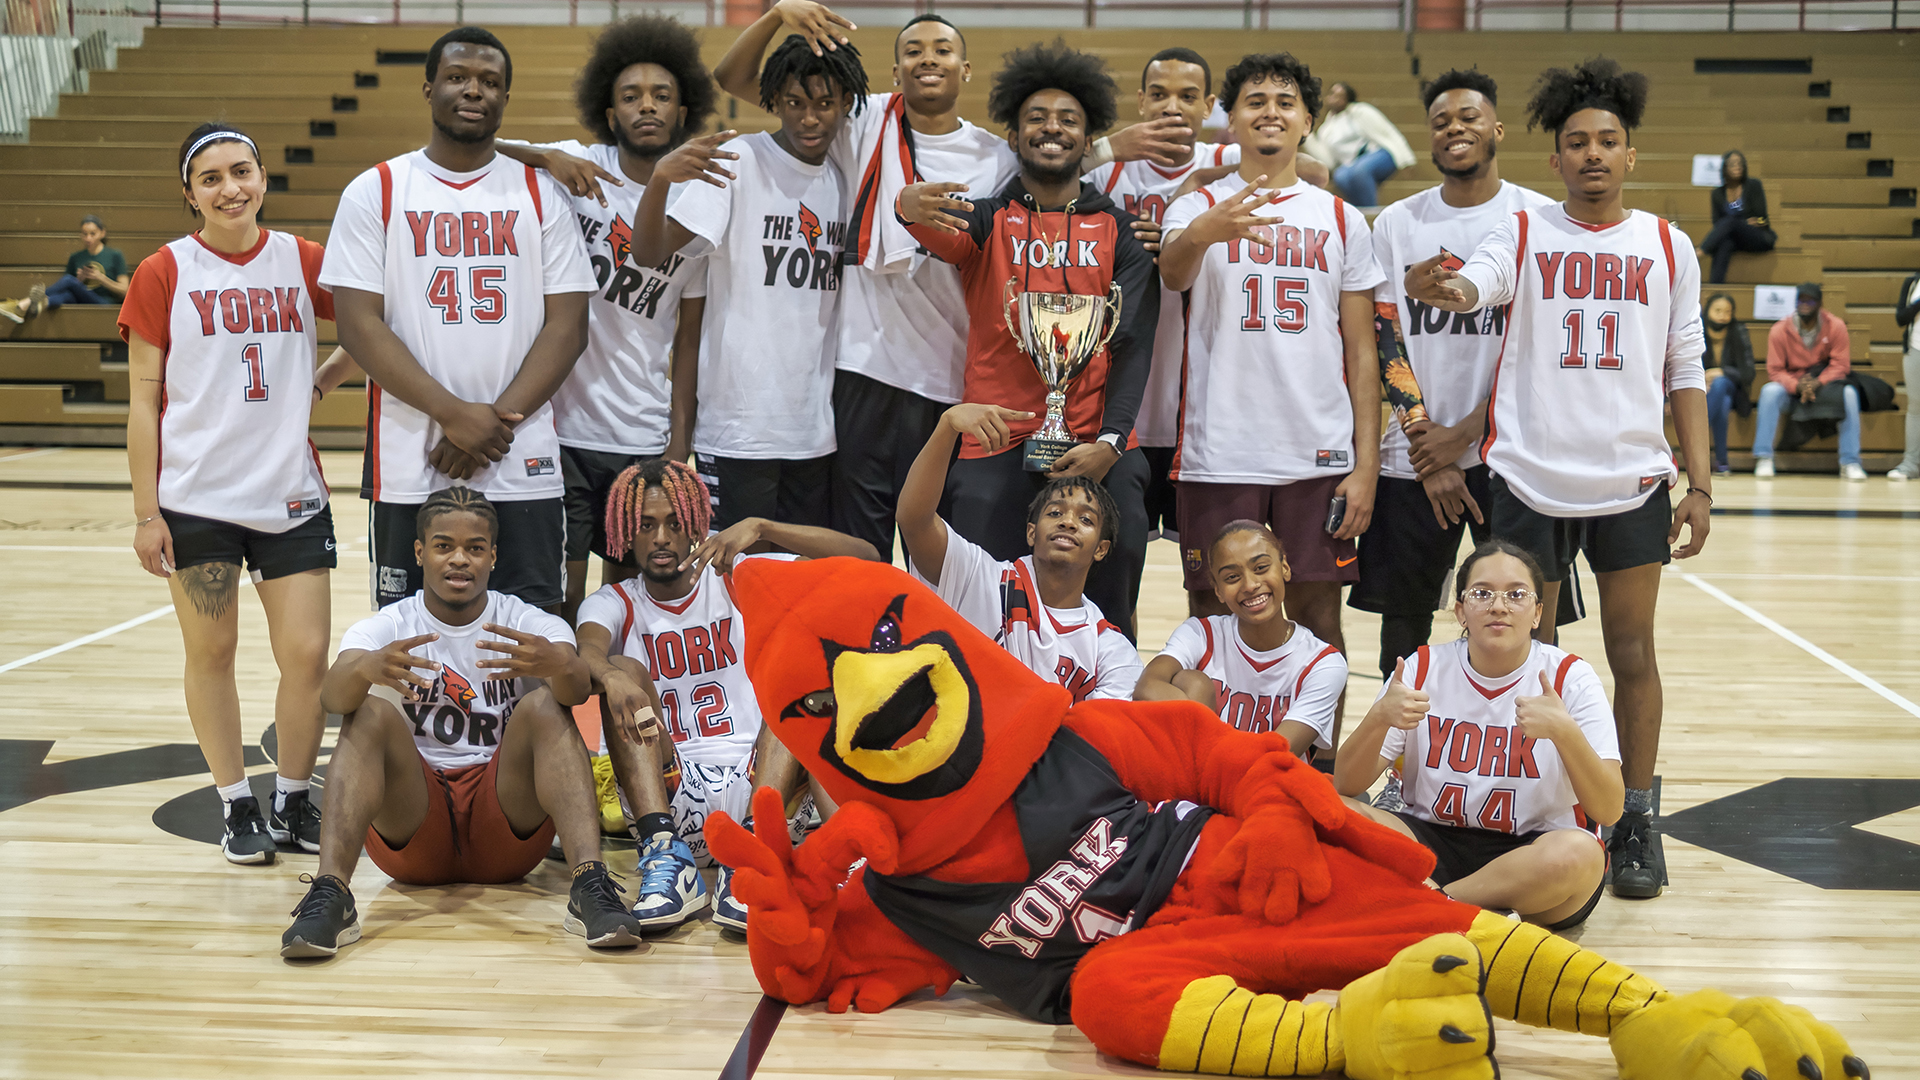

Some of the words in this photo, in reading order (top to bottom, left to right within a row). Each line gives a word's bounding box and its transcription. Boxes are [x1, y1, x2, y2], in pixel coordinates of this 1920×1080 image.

[404, 209, 520, 257] YORK
[577, 212, 604, 245] HE
[655, 253, 685, 278] AY
[763, 214, 794, 241] THE
[826, 220, 847, 247] WA
[1010, 235, 1101, 269] YORK
[425, 265, 508, 325] 45
[590, 254, 670, 320] ORK
[631, 277, 658, 314] HOOPS
[1241, 273, 1309, 335] 15
[1534, 251, 1655, 307] YORK
[188, 286, 304, 336] YORK
[1560, 309, 1624, 371] 11
[241, 342, 269, 402] 1
[306, 501, 316, 509] M
[482, 678, 516, 708] WAY
[1054, 654, 1096, 706] RK
[660, 681, 735, 744] 12
[1425, 714, 1542, 779] YORK
[1431, 782, 1518, 835] 44
[978, 816, 1129, 960] YORK
